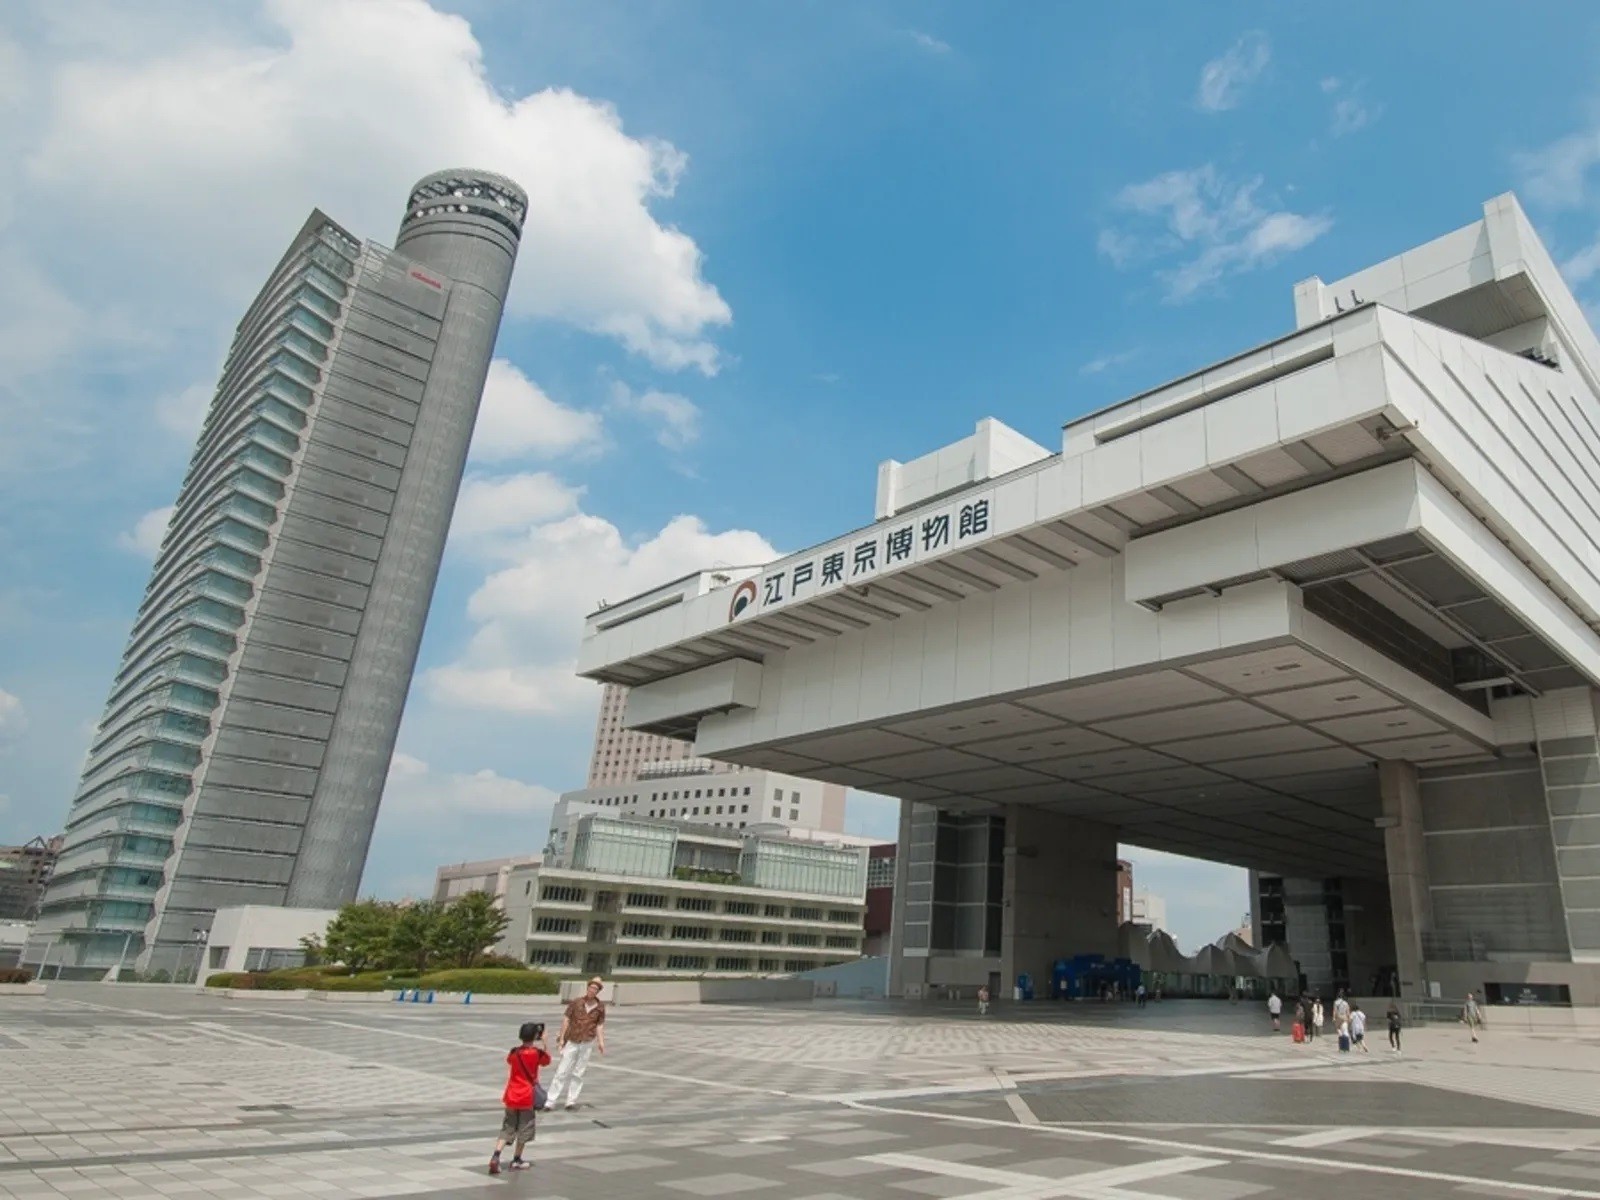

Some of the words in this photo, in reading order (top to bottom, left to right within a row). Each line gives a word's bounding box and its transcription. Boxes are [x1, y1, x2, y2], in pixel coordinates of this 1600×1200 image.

[763, 500, 989, 606] 江戸東京博物館
